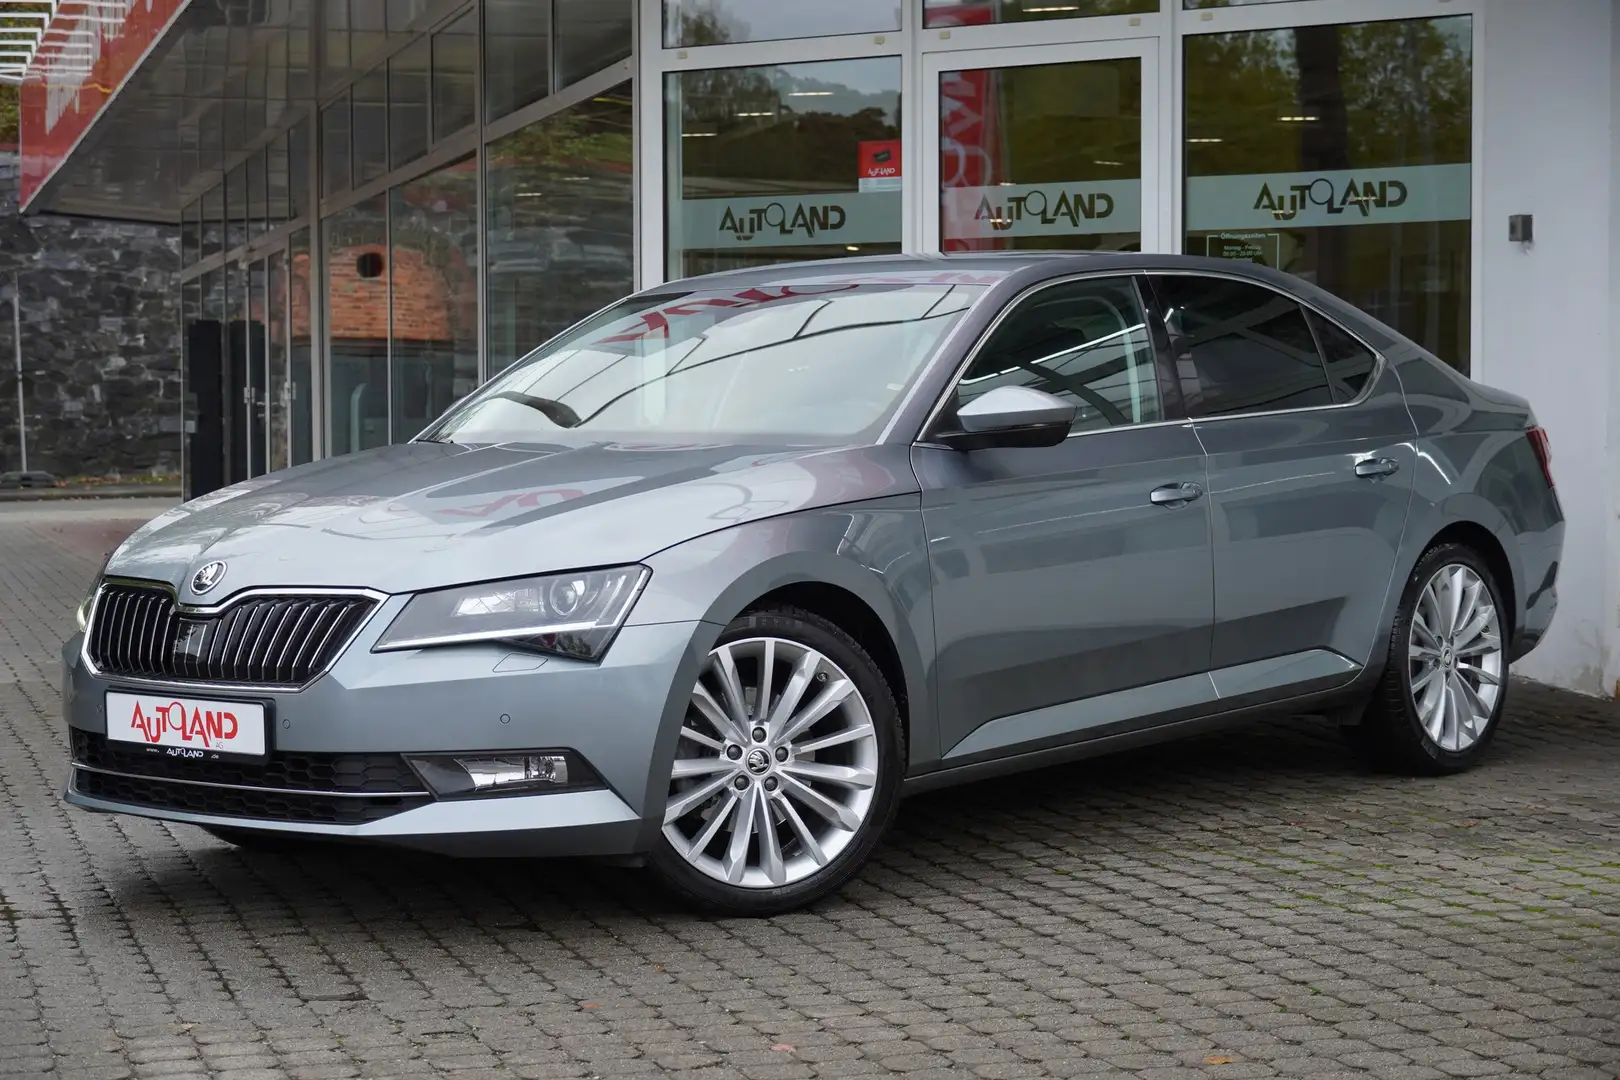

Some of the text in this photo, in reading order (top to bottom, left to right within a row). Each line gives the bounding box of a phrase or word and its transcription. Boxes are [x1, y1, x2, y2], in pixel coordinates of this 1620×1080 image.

[974, 190, 1114, 231] AUTOLAND
[1253, 178, 1408, 221] AUTOLAND
[719, 200, 846, 241] AUTOLAND
[131, 700, 238, 748] AUTOLAND
[166, 747, 204, 759] AUTOLAND
